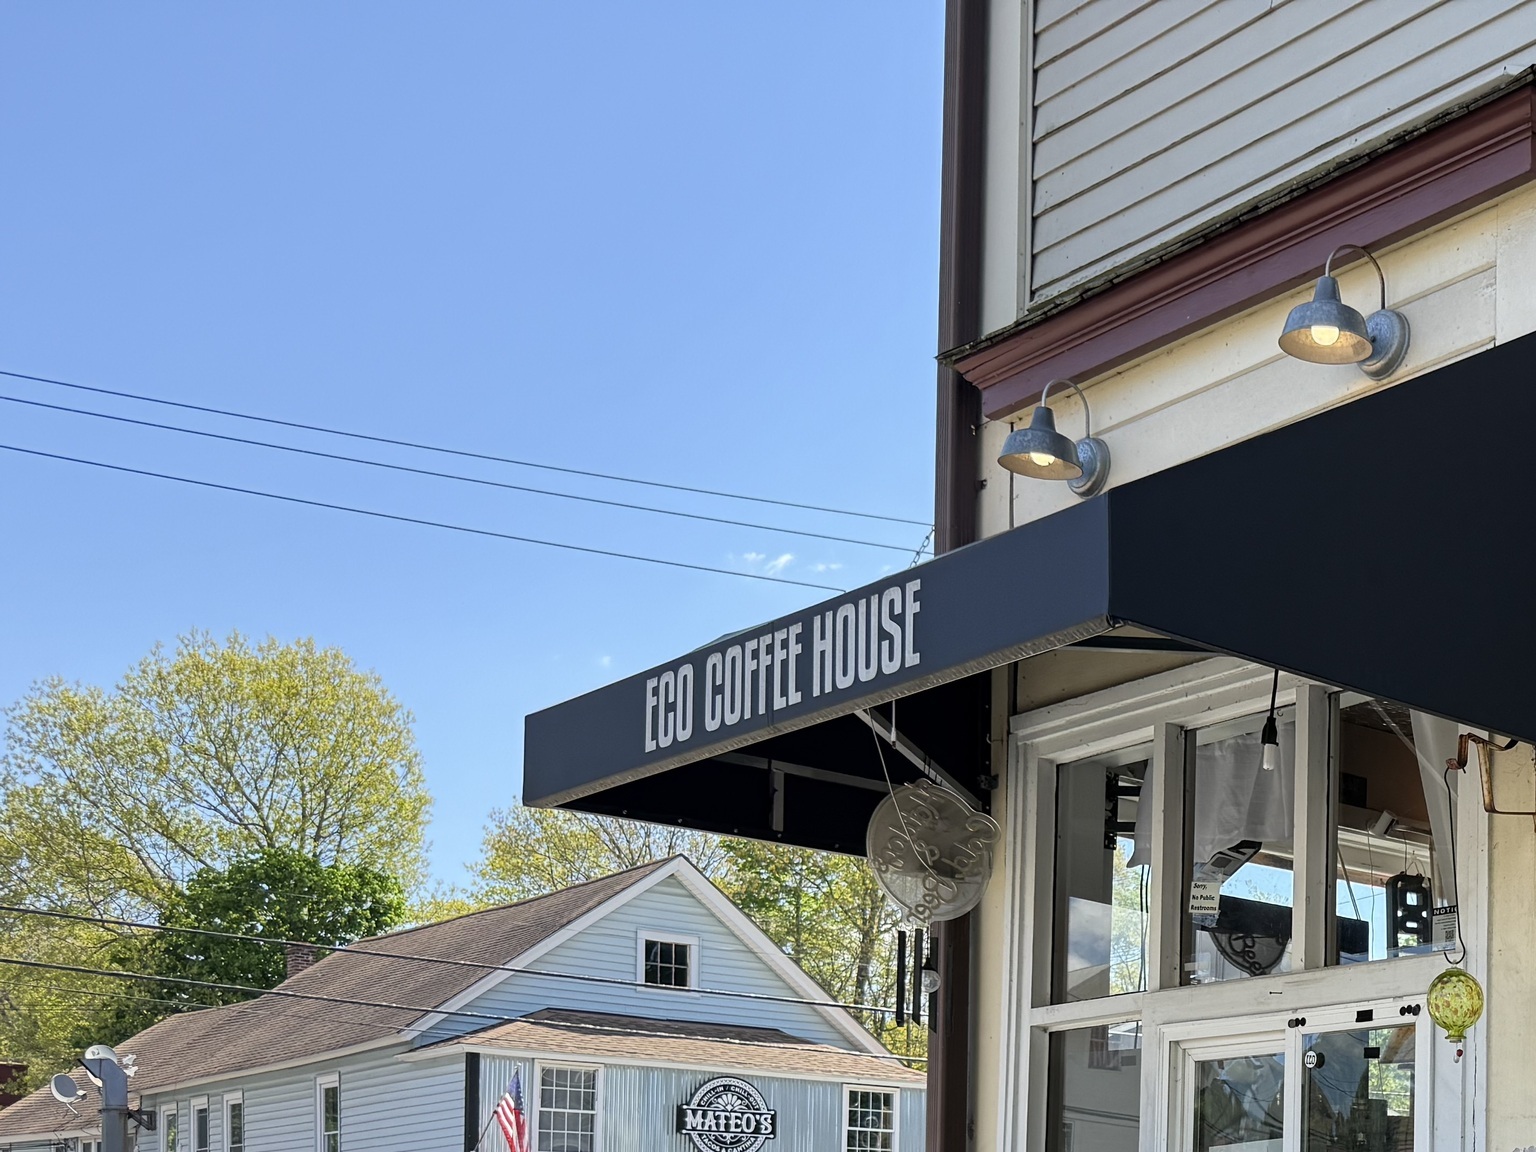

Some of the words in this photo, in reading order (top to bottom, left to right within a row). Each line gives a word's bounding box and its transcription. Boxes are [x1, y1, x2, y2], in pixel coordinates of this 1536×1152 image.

[645, 663, 693, 753] ECO
[704, 622, 802, 732] COFFEE
[812, 578, 921, 697] HOUSE
[685, 1110, 773, 1134] MATEO'S
[702, 1135, 720, 1152] TACOS
